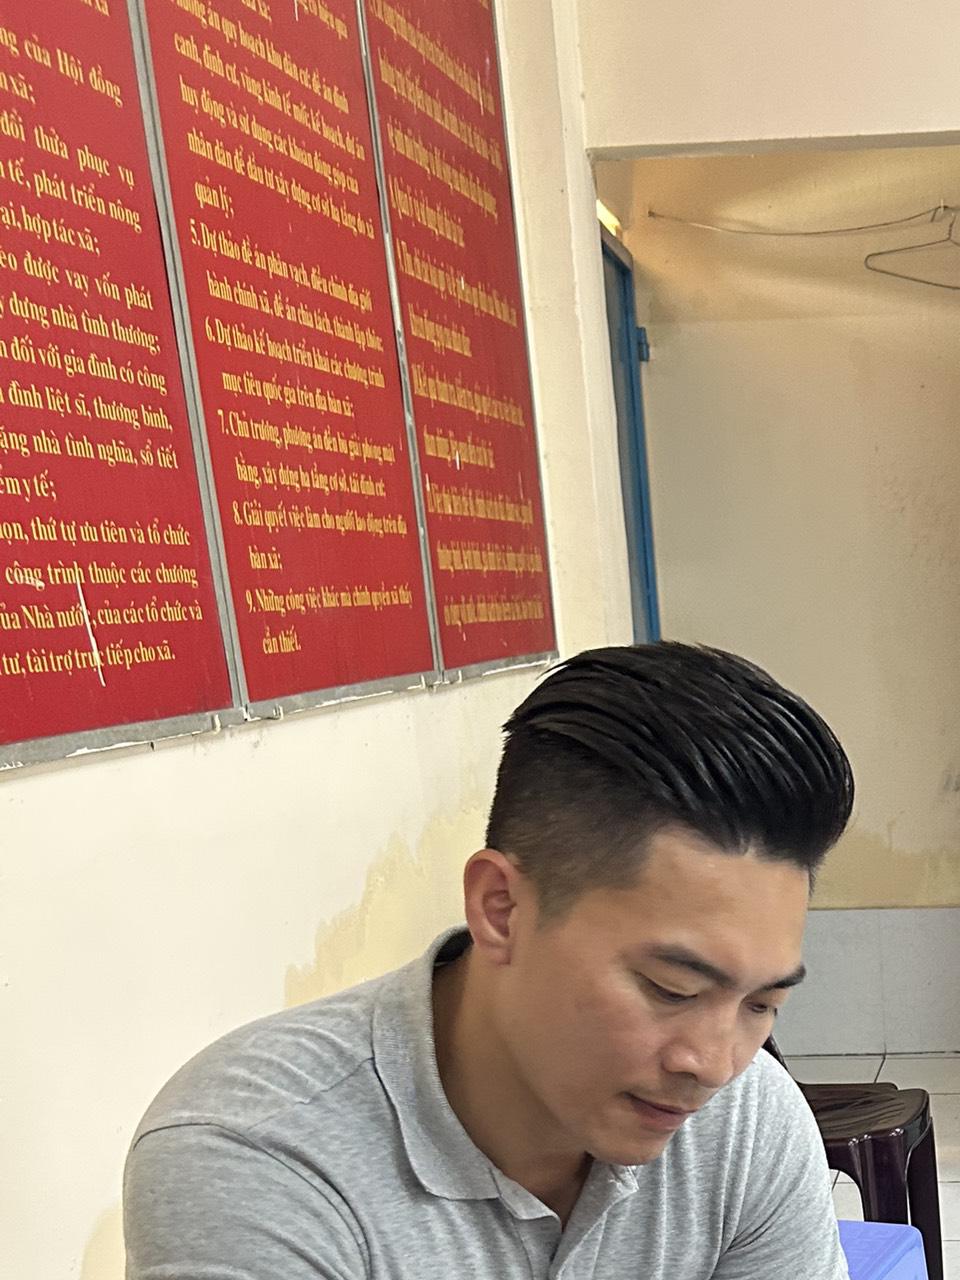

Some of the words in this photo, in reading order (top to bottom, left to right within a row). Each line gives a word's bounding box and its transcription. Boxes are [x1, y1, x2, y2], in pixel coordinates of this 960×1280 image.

[9, 73, 36, 105] xã;
[24, 34, 52, 68] của
[56, 48, 84, 86] Hội
[89, 64, 123, 108] đồng
[34, 125, 69, 160] thửa
[76, 145, 110, 178] phục
[118, 165, 135, 191] vụ
[7, 157, 31, 191] tế,
[33, 169, 68, 201] phát
[70, 182, 106, 216] triển
[108, 199, 142, 234] nông
[21, 205, 52, 244] hợp
[52, 218, 76, 246] tác
[76, 227, 100, 257] xã;
[23, 250, 60, 286] được
[64, 269, 89, 298] vay
[94, 271, 121, 301] vốn
[124, 282, 154, 311] phát
[9, 291, 51, 330] dựng
[50, 303, 80, 331] nhà
[80, 309, 110, 339] tình
[111, 318, 161, 356] thương;
[10, 334, 37, 365] đối
[37, 342, 62, 370] với
[63, 348, 86, 378] gia
[87, 352, 118, 381] đình
[119, 360, 135, 385] có
[136, 365, 168, 397] công
[8, 380, 44, 410] đình
[44, 386, 72, 418] liệt
[74, 393, 92, 420] sĩ,
[92, 396, 141, 431] thương
[140, 404, 173, 434] binh,
[32, 429, 62, 455] nhà
[64, 432, 95, 459] tình
[96, 439, 139, 467] nghĩa,
[139, 439, 154, 466] sổ
[156, 444, 179, 469] tiết
[23, 479, 31, 503] y
[32, 469, 57, 502] tế;
[30, 516, 58, 542] thứ
[59, 520, 78, 547] tự
[79, 521, 99, 543] ưu
[99, 520, 128, 543] tiên
[129, 521, 146, 544] và
[146, 518, 161, 545] tổ
[163, 524, 191, 546] chức
[5, 560, 46, 592] công
[47, 561, 86, 585] trình
[87, 561, 127, 589] thuộc
[130, 560, 152, 584] các
[155, 562, 199, 589] chương
[21, 604, 56, 629] Nhà
[97, 599, 122, 625] của
[122, 601, 145, 625] các
[144, 596, 159, 623] tổ
[160, 600, 188, 622] chức
[188, 600, 203, 621] và
[26, 648, 50, 673] tài
[49, 649, 73, 676] trợ
[105, 639, 133, 671] tiếp
[133, 641, 156, 664] cho
[156, 639, 176, 661] xã.
